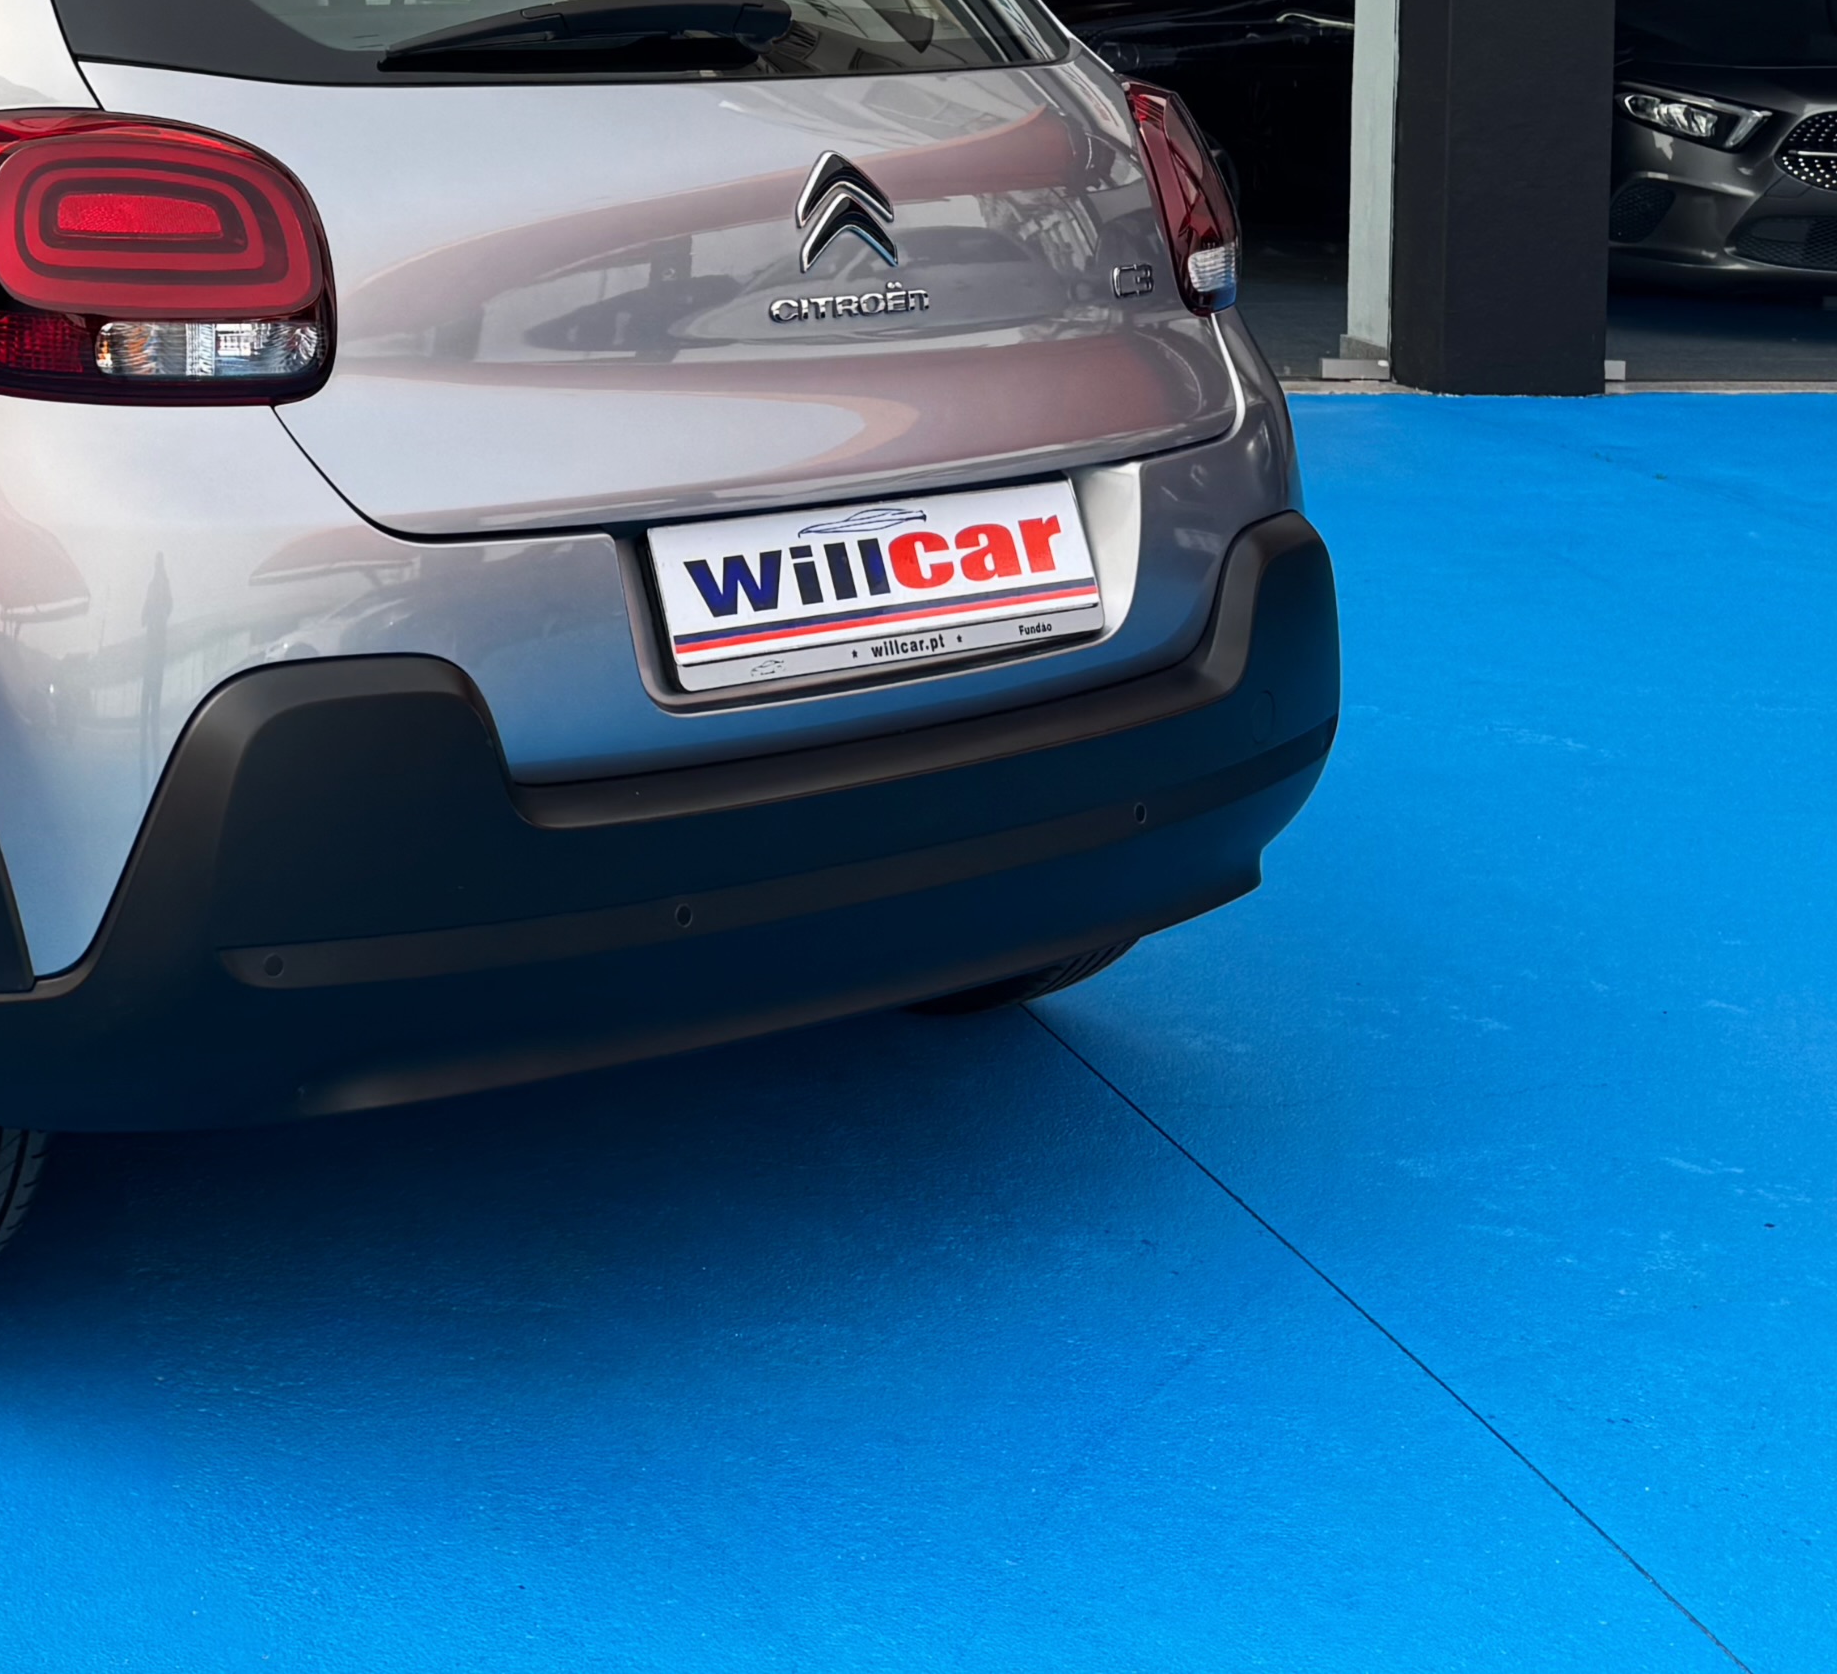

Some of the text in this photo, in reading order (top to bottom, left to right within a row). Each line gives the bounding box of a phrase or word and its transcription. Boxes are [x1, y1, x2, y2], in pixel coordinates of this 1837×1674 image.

[1110, 262, 1155, 299] C3
[768, 280, 931, 324] CITROËN
[870, 633, 946, 658] willcar.pt
